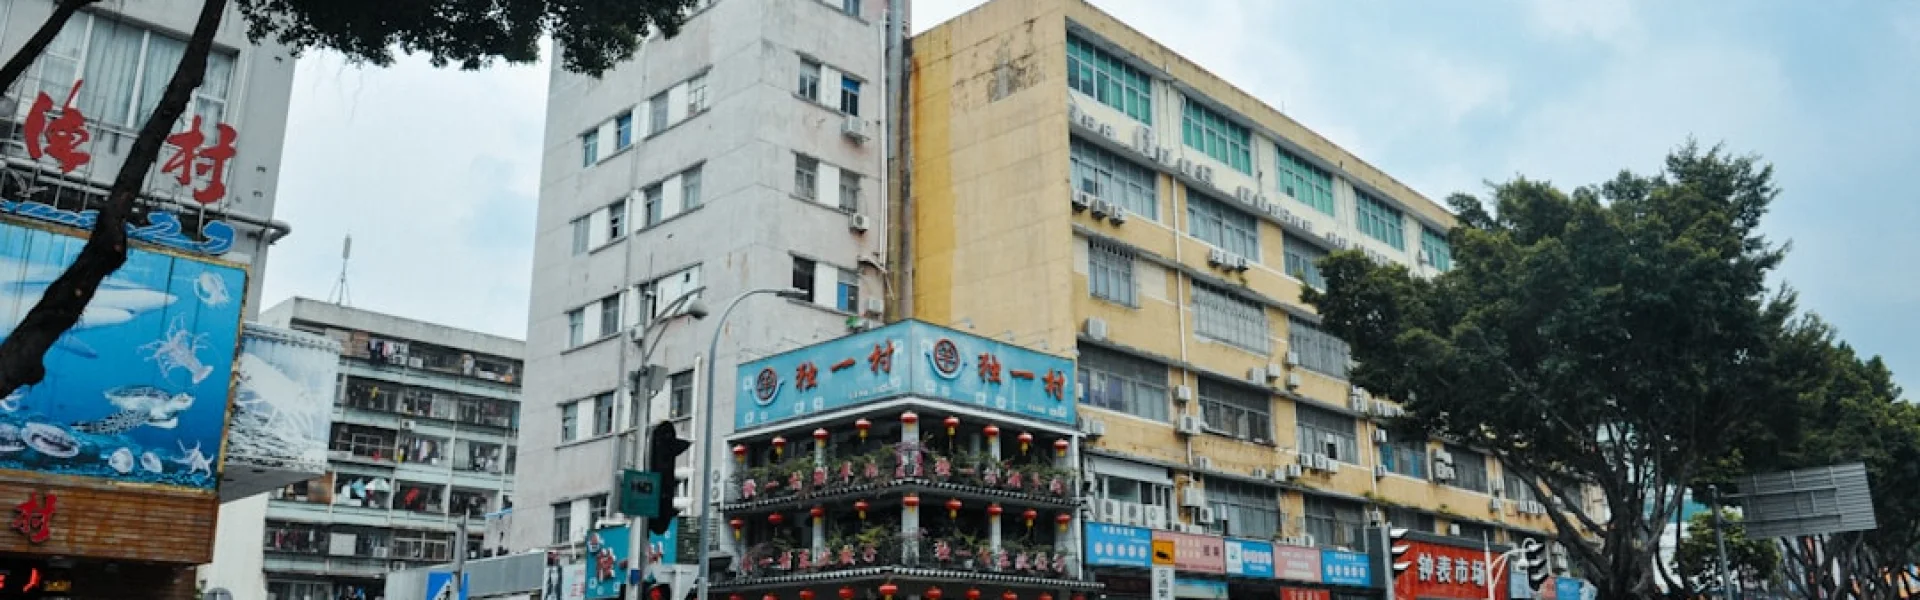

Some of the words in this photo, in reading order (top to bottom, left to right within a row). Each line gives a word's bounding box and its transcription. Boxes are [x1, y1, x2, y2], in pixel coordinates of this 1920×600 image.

[796, 339, 894, 392] 独一村
[978, 353, 1064, 401] 独一村
[1418, 553, 1485, 586] 钟表市场
